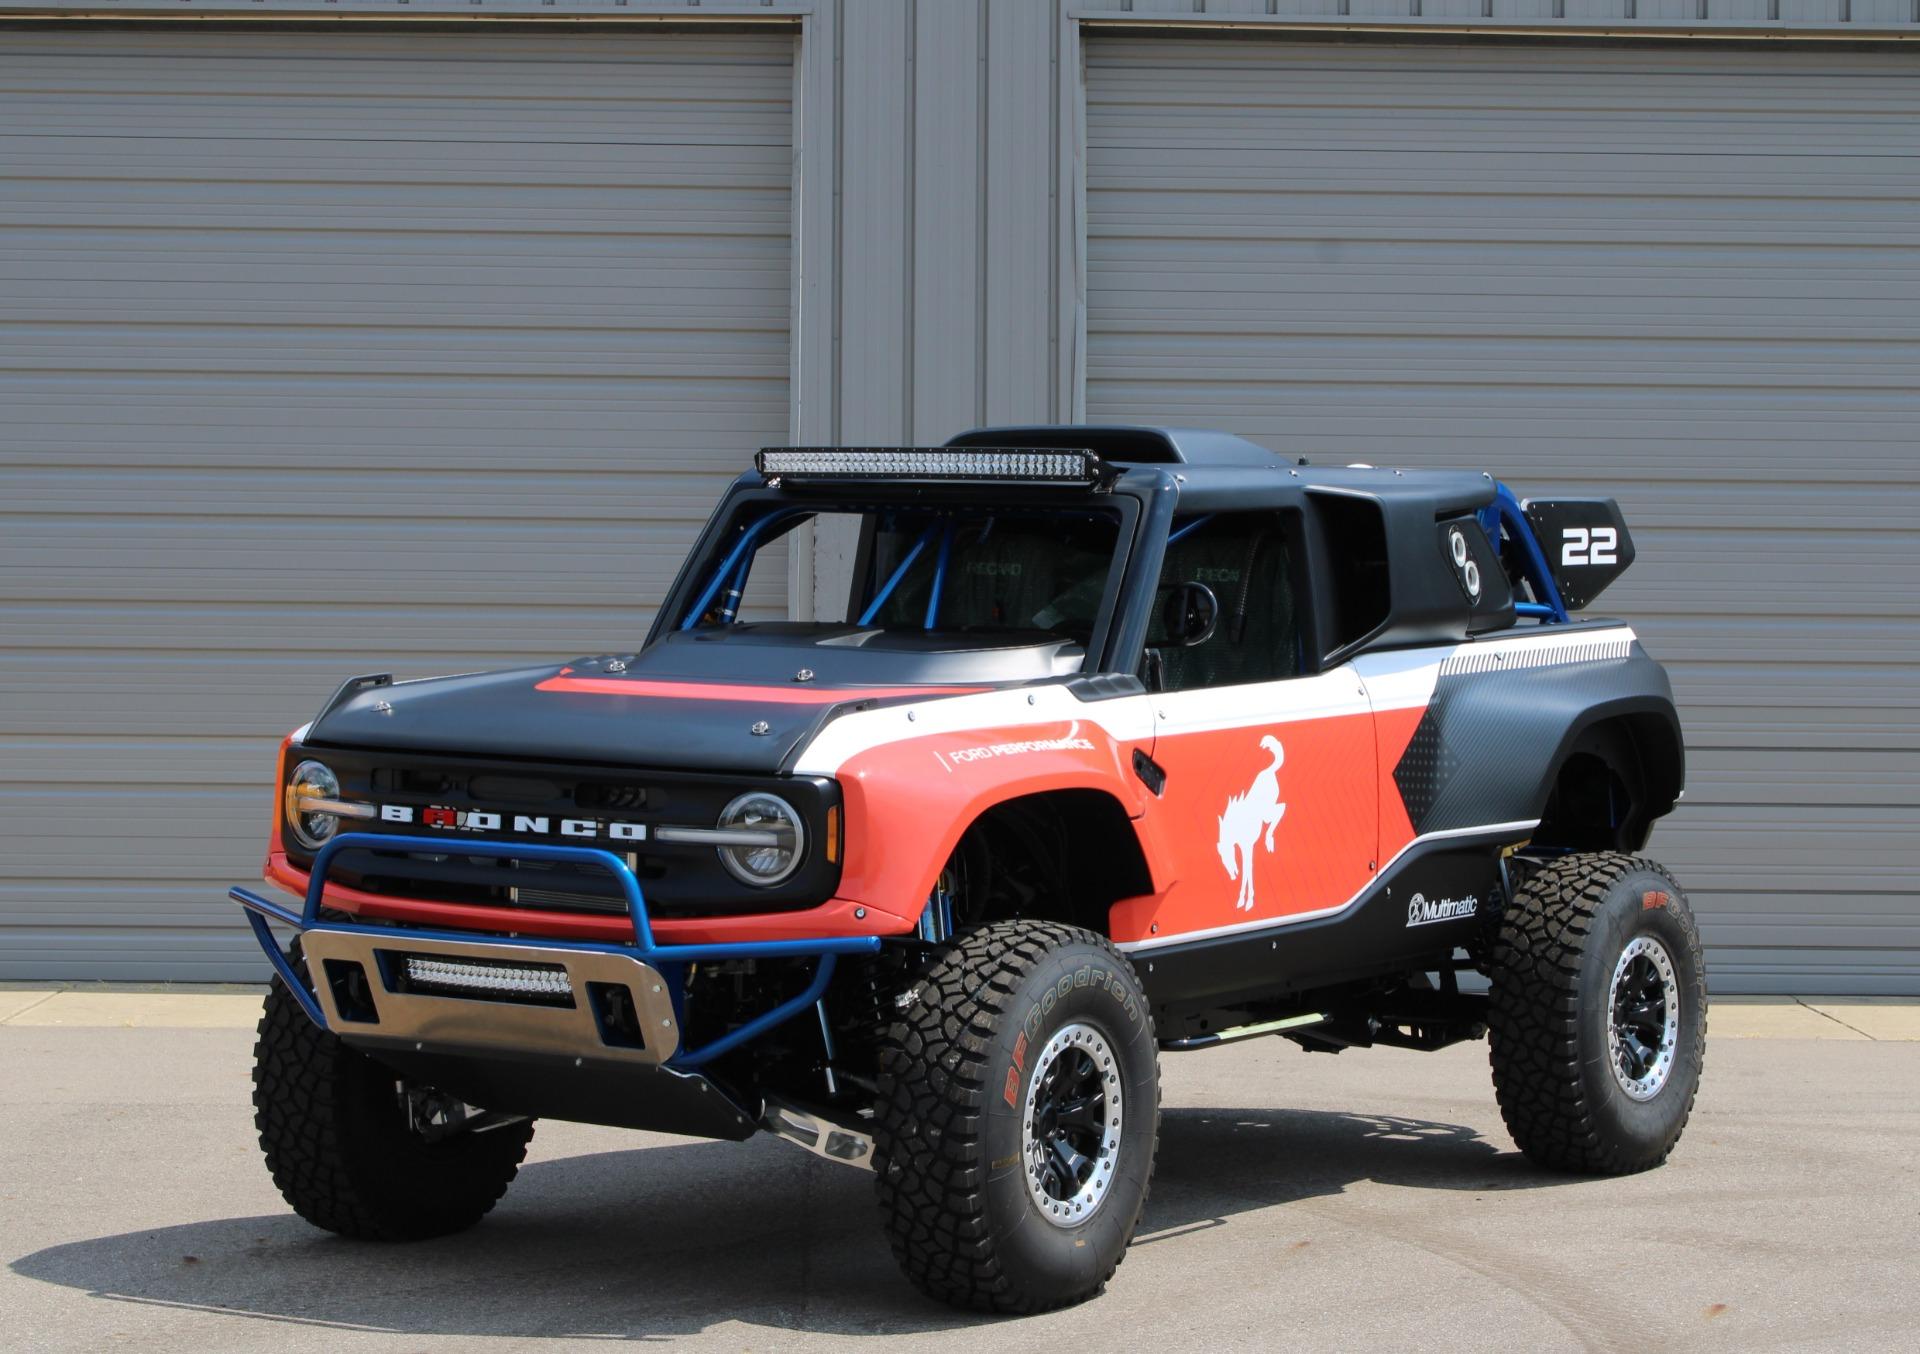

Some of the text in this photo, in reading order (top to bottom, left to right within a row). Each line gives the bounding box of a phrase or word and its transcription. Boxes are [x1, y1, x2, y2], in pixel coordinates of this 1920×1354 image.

[1562, 527, 1617, 566] 22
[949, 738, 1095, 764] FORD PERFORMANCE
[381, 804, 647, 841] BRONCO
[1423, 895, 1478, 920] Multimatic
